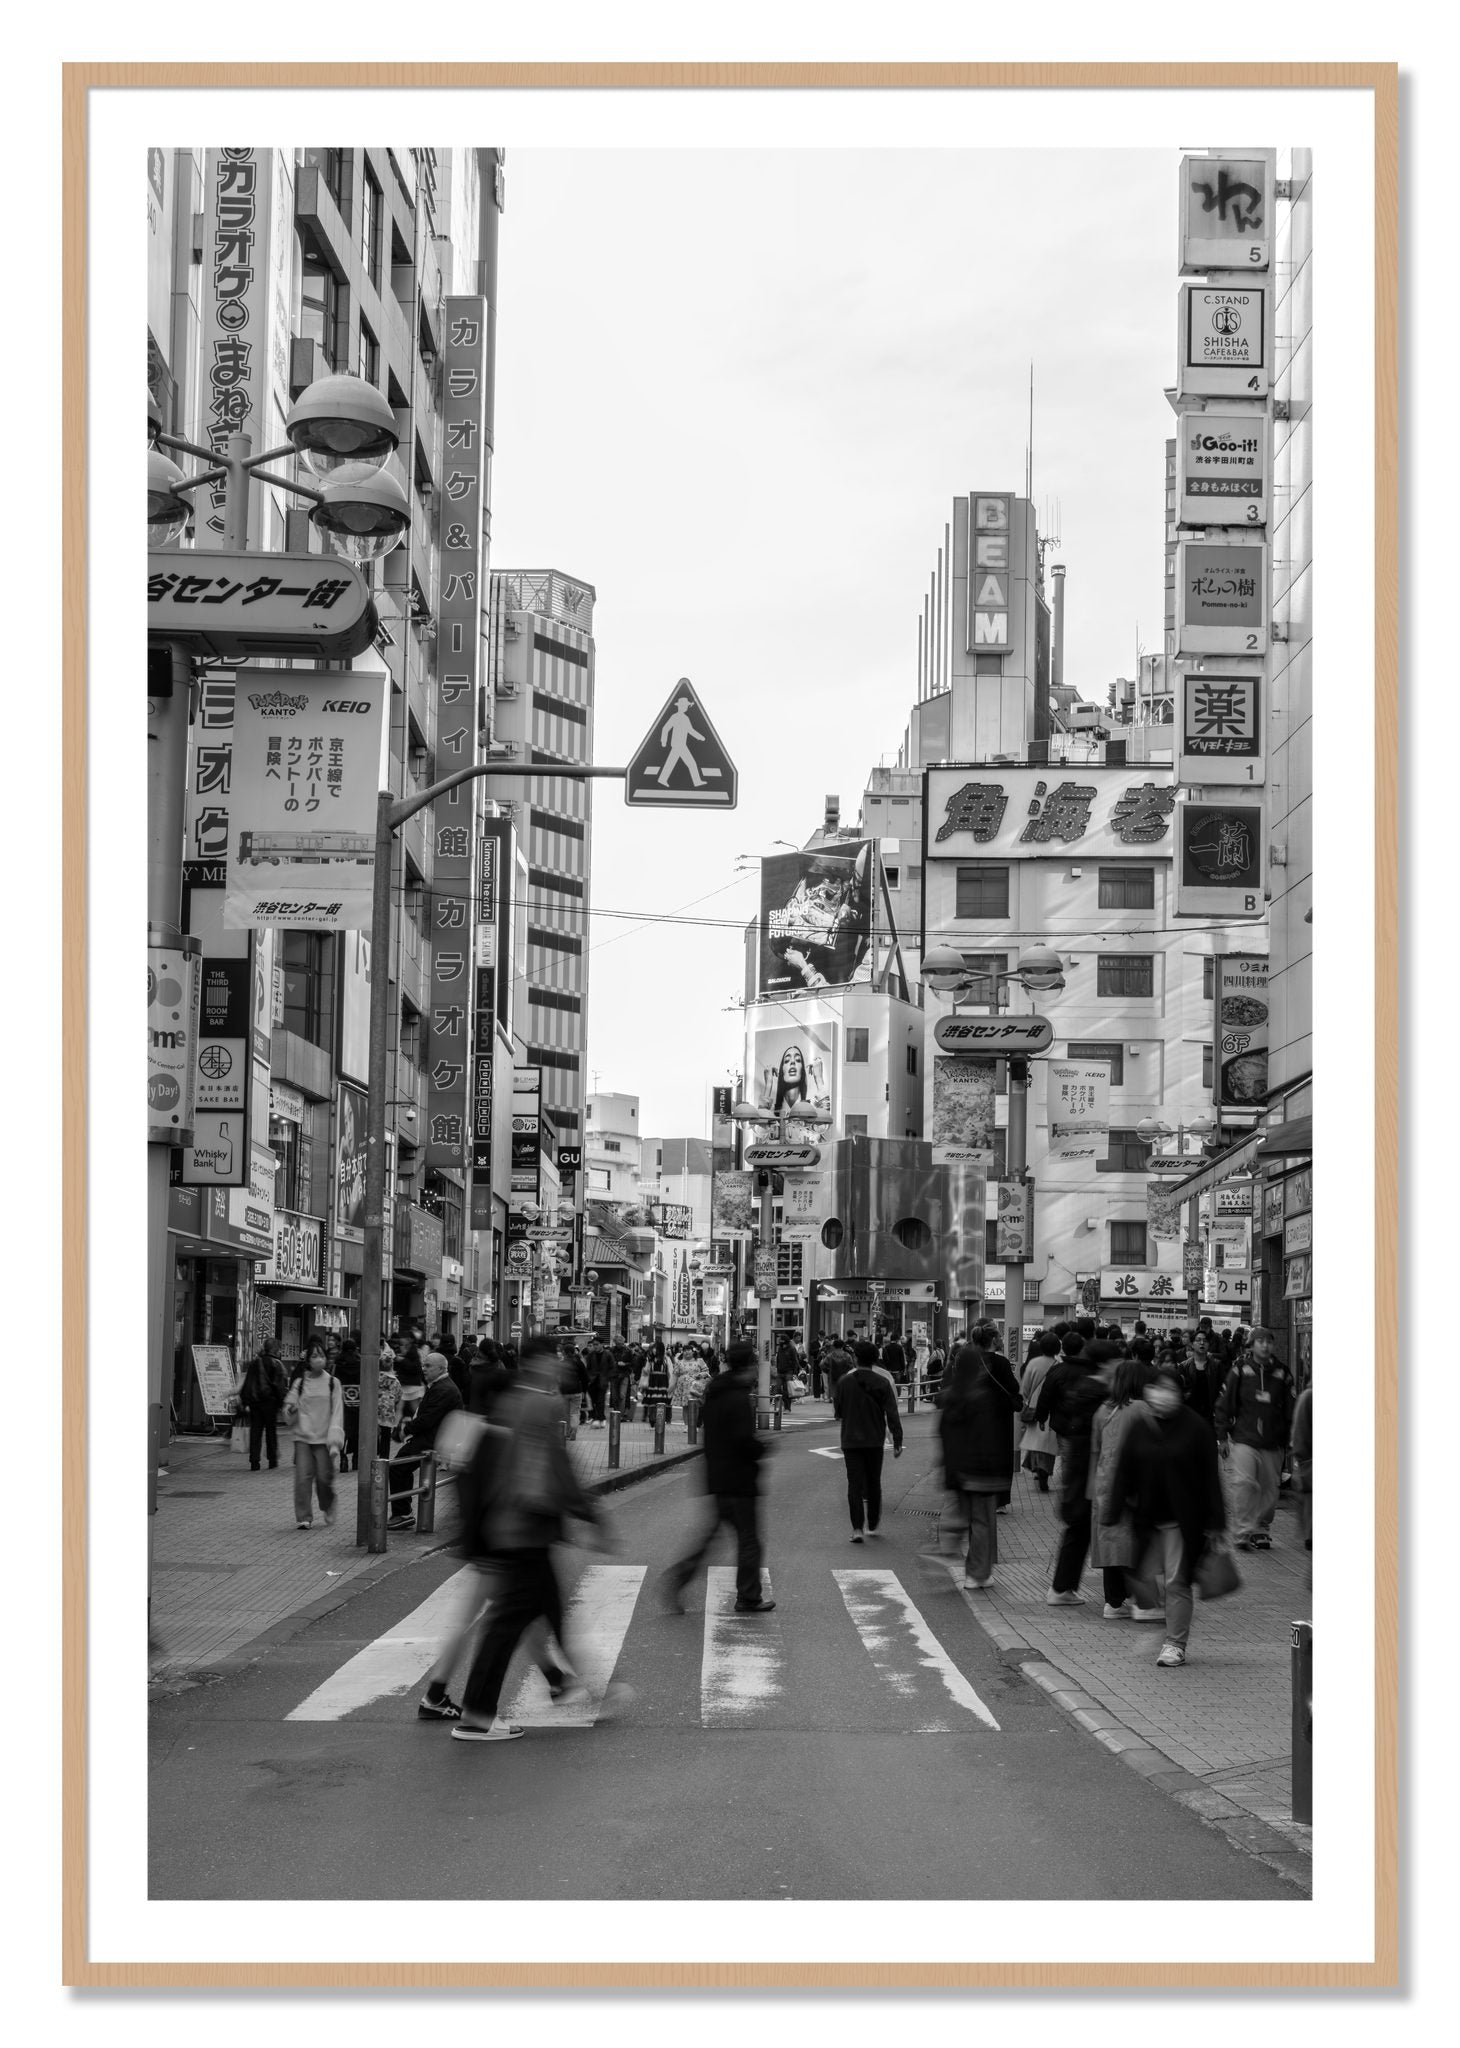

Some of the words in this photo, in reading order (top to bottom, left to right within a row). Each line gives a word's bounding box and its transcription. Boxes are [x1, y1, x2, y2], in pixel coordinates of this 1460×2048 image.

[215, 160, 257, 301] カラオケ
[1250, 247, 1261, 262] 5
[1204, 296, 1250, 306] C.STAND
[1204, 337, 1249, 347] SHISHA
[1203, 348, 1249, 356] CAFE&BAR
[1248, 376, 1260, 391] 4
[1203, 436, 1258, 452] Goo-it!
[1196, 456, 1254, 465] 渋谷宇田川町店
[1190, 481, 1259, 493] 全身もみほぐし
[1247, 504, 1259, 521] 3
[974, 498, 1008, 645] BEAM
[1246, 633, 1258, 650] 2
[261, 708, 296, 716] KANTO
[322, 700, 372, 714] KEIO
[1195, 684, 1246, 735] 薬
[1188, 737, 1251, 752] マツモトキヨシ
[265, 736, 281, 780] 冒険へ
[284, 737, 303, 812] カントーの
[305, 737, 323, 812] ポケパーク
[327, 738, 344, 798] 京王線で
[1245, 764, 1254, 780] 1
[935, 781, 1179, 843] 角海老
[484, 842, 493, 878] kimono
[252, 902, 343, 915] 渋谷センター街
[483, 883, 492, 918] hearts
[1245, 894, 1256, 912] B
[1223, 975, 1268, 988] 四川料理
[942, 1025, 1046, 1038] 渋谷センター街
[1222, 1034, 1250, 1053] 6F
[158, 1083, 178, 1098] Day!
[194, 1149, 228, 1161] Whisky
[560, 1153, 580, 1163] GU
[748, 1149, 812, 1159] 渋谷センター街
[193, 1159, 214, 1168] Bank
[282, 1226, 296, 1277] 50
[1114, 1274, 1175, 1296] 兆楽
[680, 1272, 689, 1315] BEER
